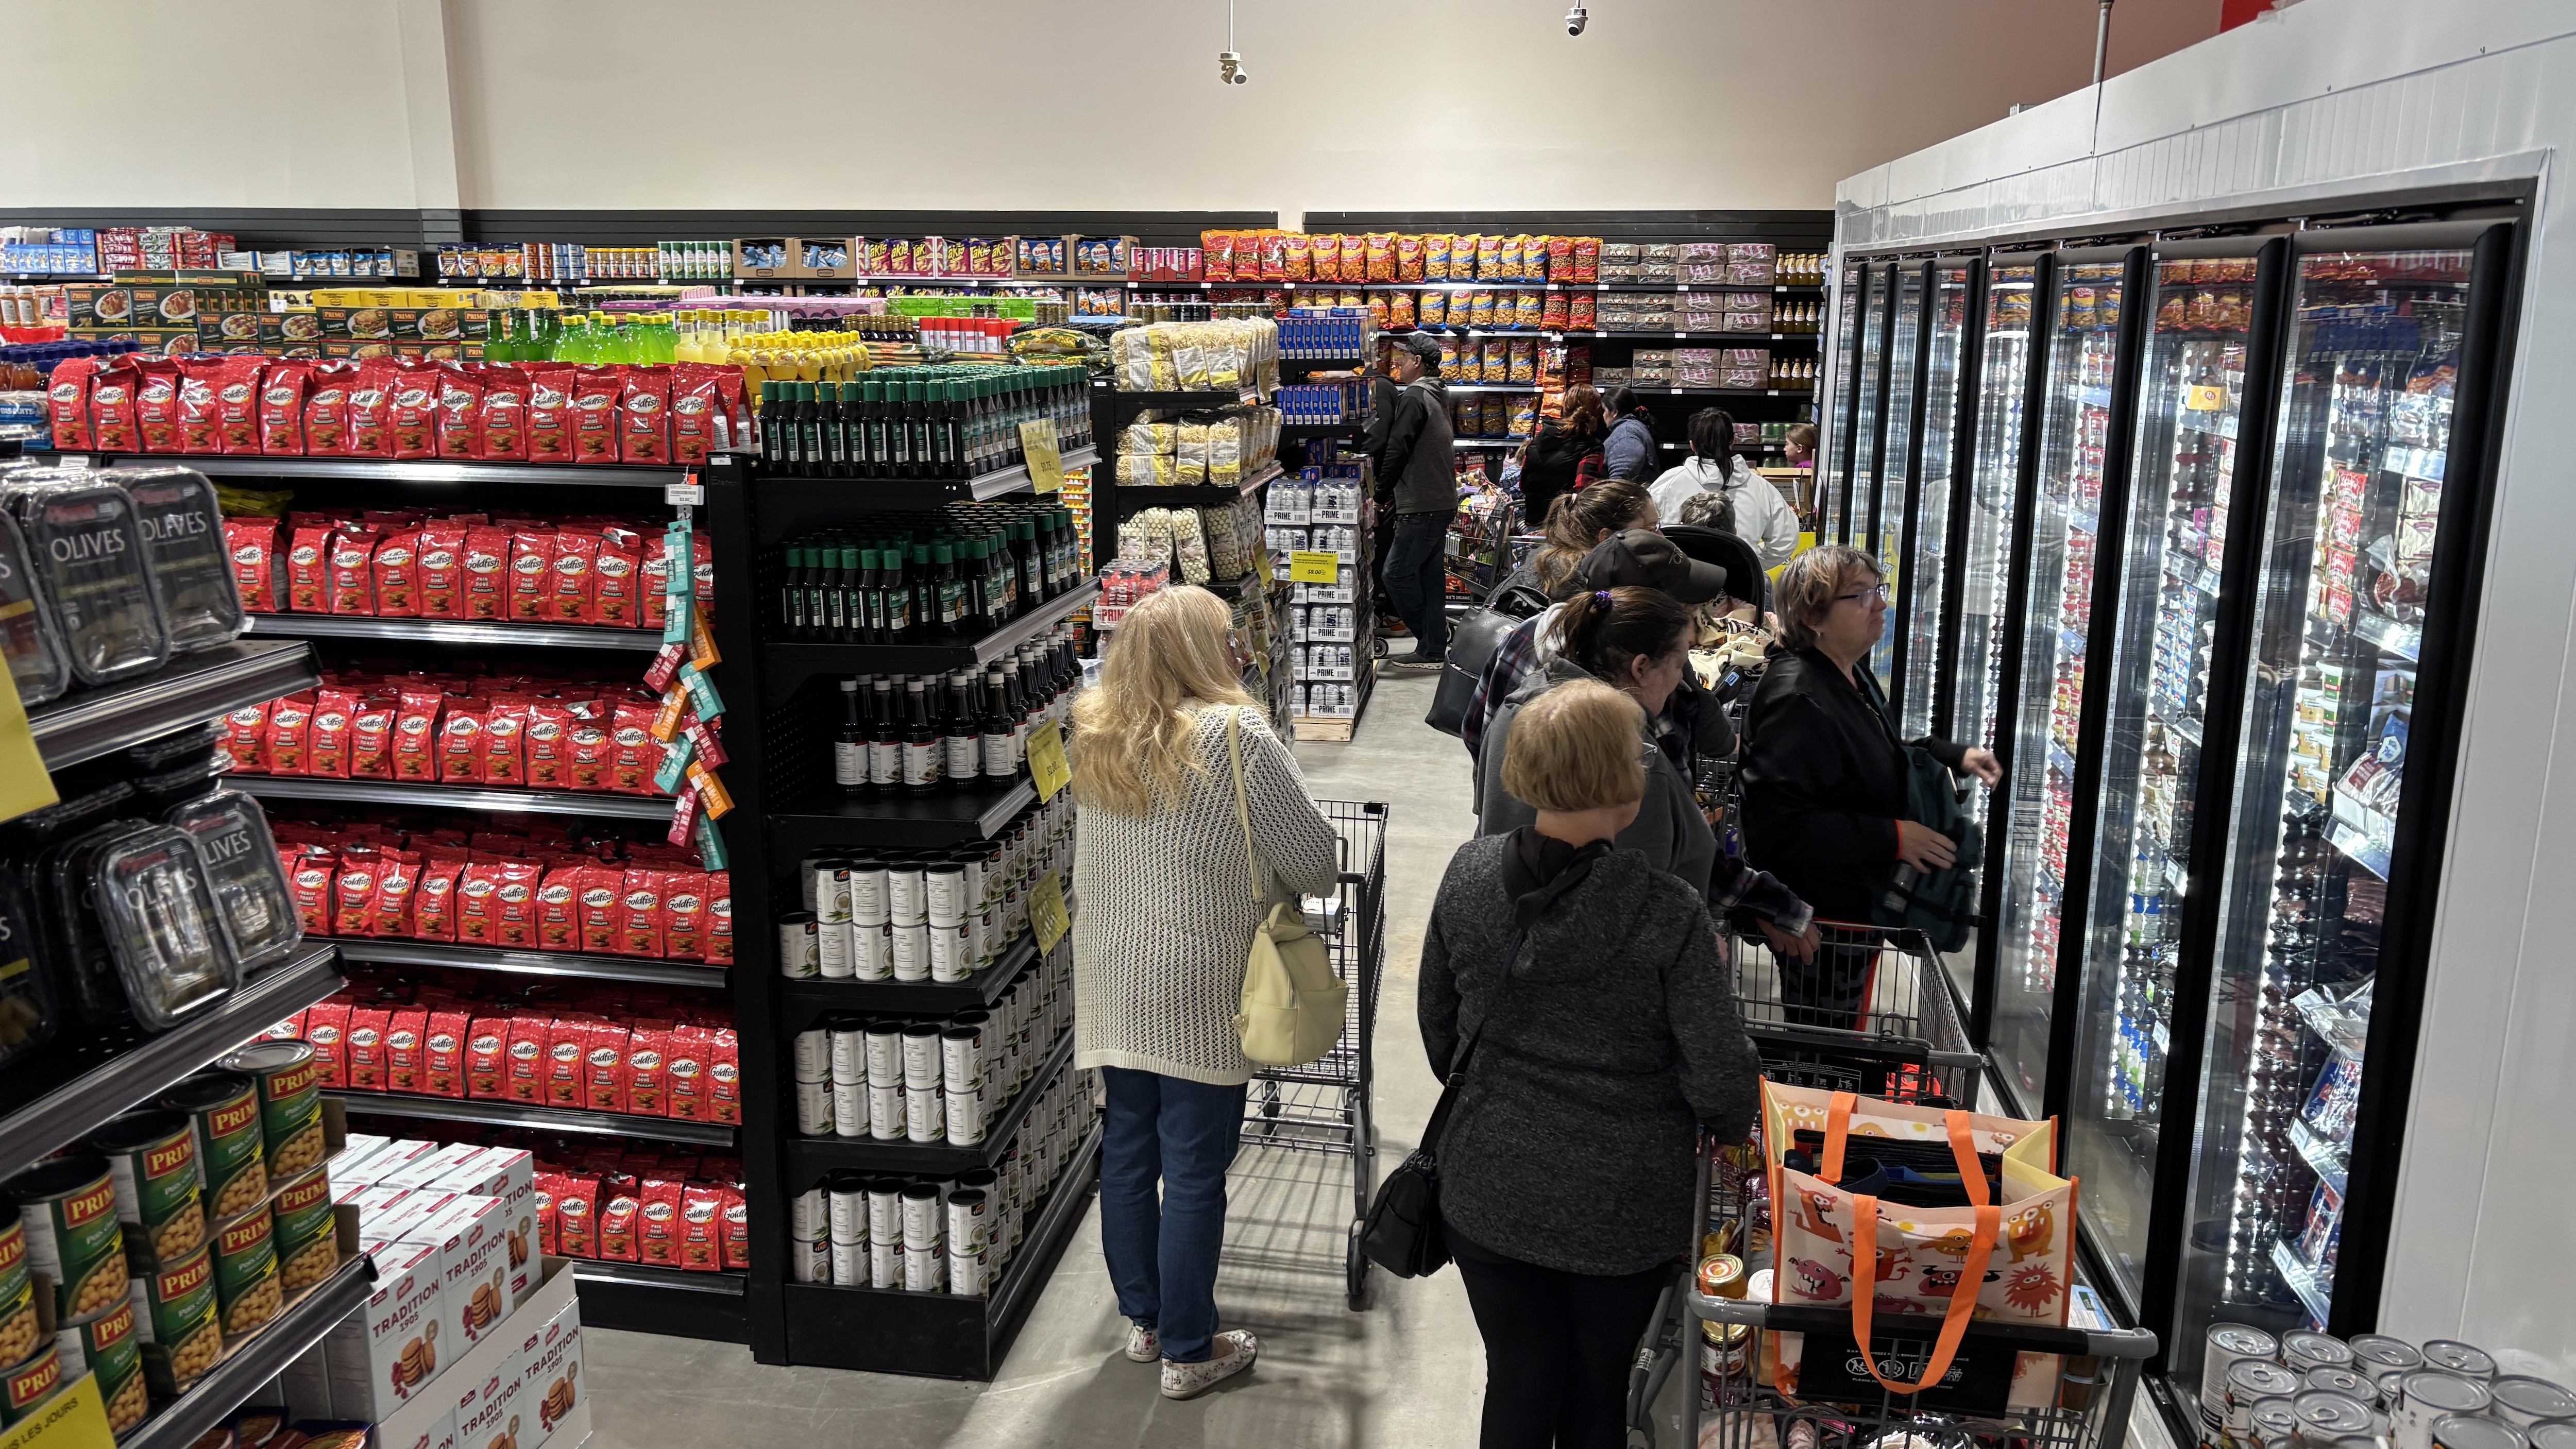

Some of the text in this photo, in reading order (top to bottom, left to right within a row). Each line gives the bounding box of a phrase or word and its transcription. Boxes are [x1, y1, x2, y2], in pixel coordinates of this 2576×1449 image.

[870, 243, 887, 258] akis
[440, 393, 474, 406] Goldfish
[486, 392, 519, 405] Goldfish
[576, 396, 610, 407] Goldfish
[1274, 512, 1291, 520] PRIME
[1321, 510, 1340, 519] PRIME
[52, 529, 125, 561] OLIVES
[421, 554, 454, 566] Goldfish
[465, 558, 500, 570] Goldfish
[514, 557, 545, 570] Goldfish
[555, 558, 587, 571] Goldfish
[598, 560, 630, 573] Goldfish
[1101, 609, 1125, 621] PRIM
[1318, 628, 1335, 637] PRIME
[529, 726, 561, 738] Goldfish
[614, 731, 646, 743] Goldfish
[201, 830, 251, 864] LIVES
[296, 874, 325, 884] Goldfish
[340, 876, 371, 887] Goldfish
[497, 887, 529, 899] Goldfish
[541, 890, 572, 900] Goldfish
[581, 892, 614, 904] Goldfish
[624, 895, 657, 906] Goldfish
[667, 899, 700, 910] Goldfish
[310, 1029, 339, 1040] Goldfish
[349, 1032, 378, 1043] Goldfish
[387, 1034, 416, 1046] Goldfish
[428, 1038, 456, 1049] Goldfish
[471, 1039, 500, 1050] Goldfish
[510, 1044, 539, 1055] Goldfish
[551, 1046, 580, 1056] Goldfish
[588, 1052, 618, 1063] Goldfish
[630, 1054, 661, 1066] Goldfish
[669, 1063, 700, 1073] Goldfish
[710, 1067, 738, 1078] Goldfish
[274, 1067, 317, 1094] PRIM
[150, 1135, 193, 1171] PRIM
[282, 1182, 328, 1207] PRIM
[71, 1182, 115, 1220] PRIM
[558, 1202, 587, 1213] Goldfish
[643, 1206, 673, 1218] Goldfish
[684, 1208, 714, 1220] Goldfish
[227, 1218, 273, 1248] PRIM
[446, 1229, 505, 1282] TRADITION
[470, 1258, 488, 1277] 1905
[165, 1263, 211, 1294] PRIM
[373, 1279, 440, 1338] TRADITION
[399, 1312, 420, 1332] 1905
[525, 1325, 579, 1379] TRADITION
[547, 1354, 563, 1373] 1905
[17, 1359, 61, 1399] PRIM
[462, 1377, 521, 1436] TRADITION
[22, 1423, 42, 1444] LES
[44, 1396, 79, 1430] JOURS
[486, 1408, 503, 1429] 1905
